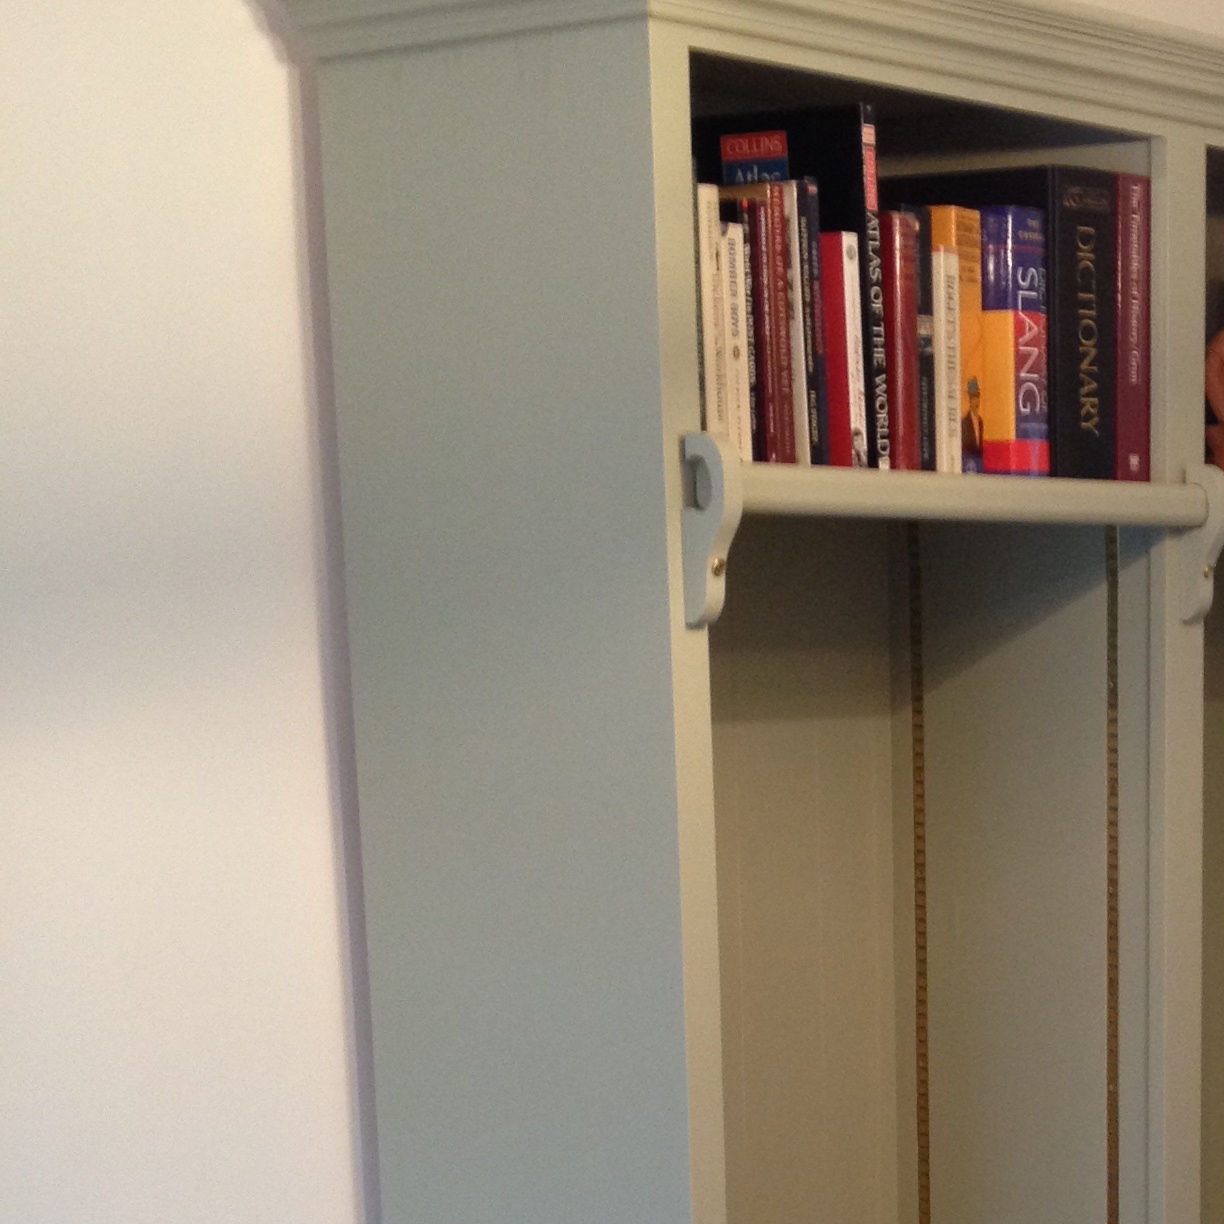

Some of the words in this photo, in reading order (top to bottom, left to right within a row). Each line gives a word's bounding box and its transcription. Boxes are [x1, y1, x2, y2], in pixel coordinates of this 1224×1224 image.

[726, 136, 782, 154] COLLINS
[727, 237, 738, 298] BOMBER
[866, 212, 882, 283] ATLAS
[730, 302, 740, 337] BOYS
[871, 286, 884, 317] OF
[1077, 225, 1100, 438] DICTIONARY
[873, 322, 886, 367] THE
[1017, 266, 1041, 414] SLANG
[874, 371, 889, 455] WORLD
